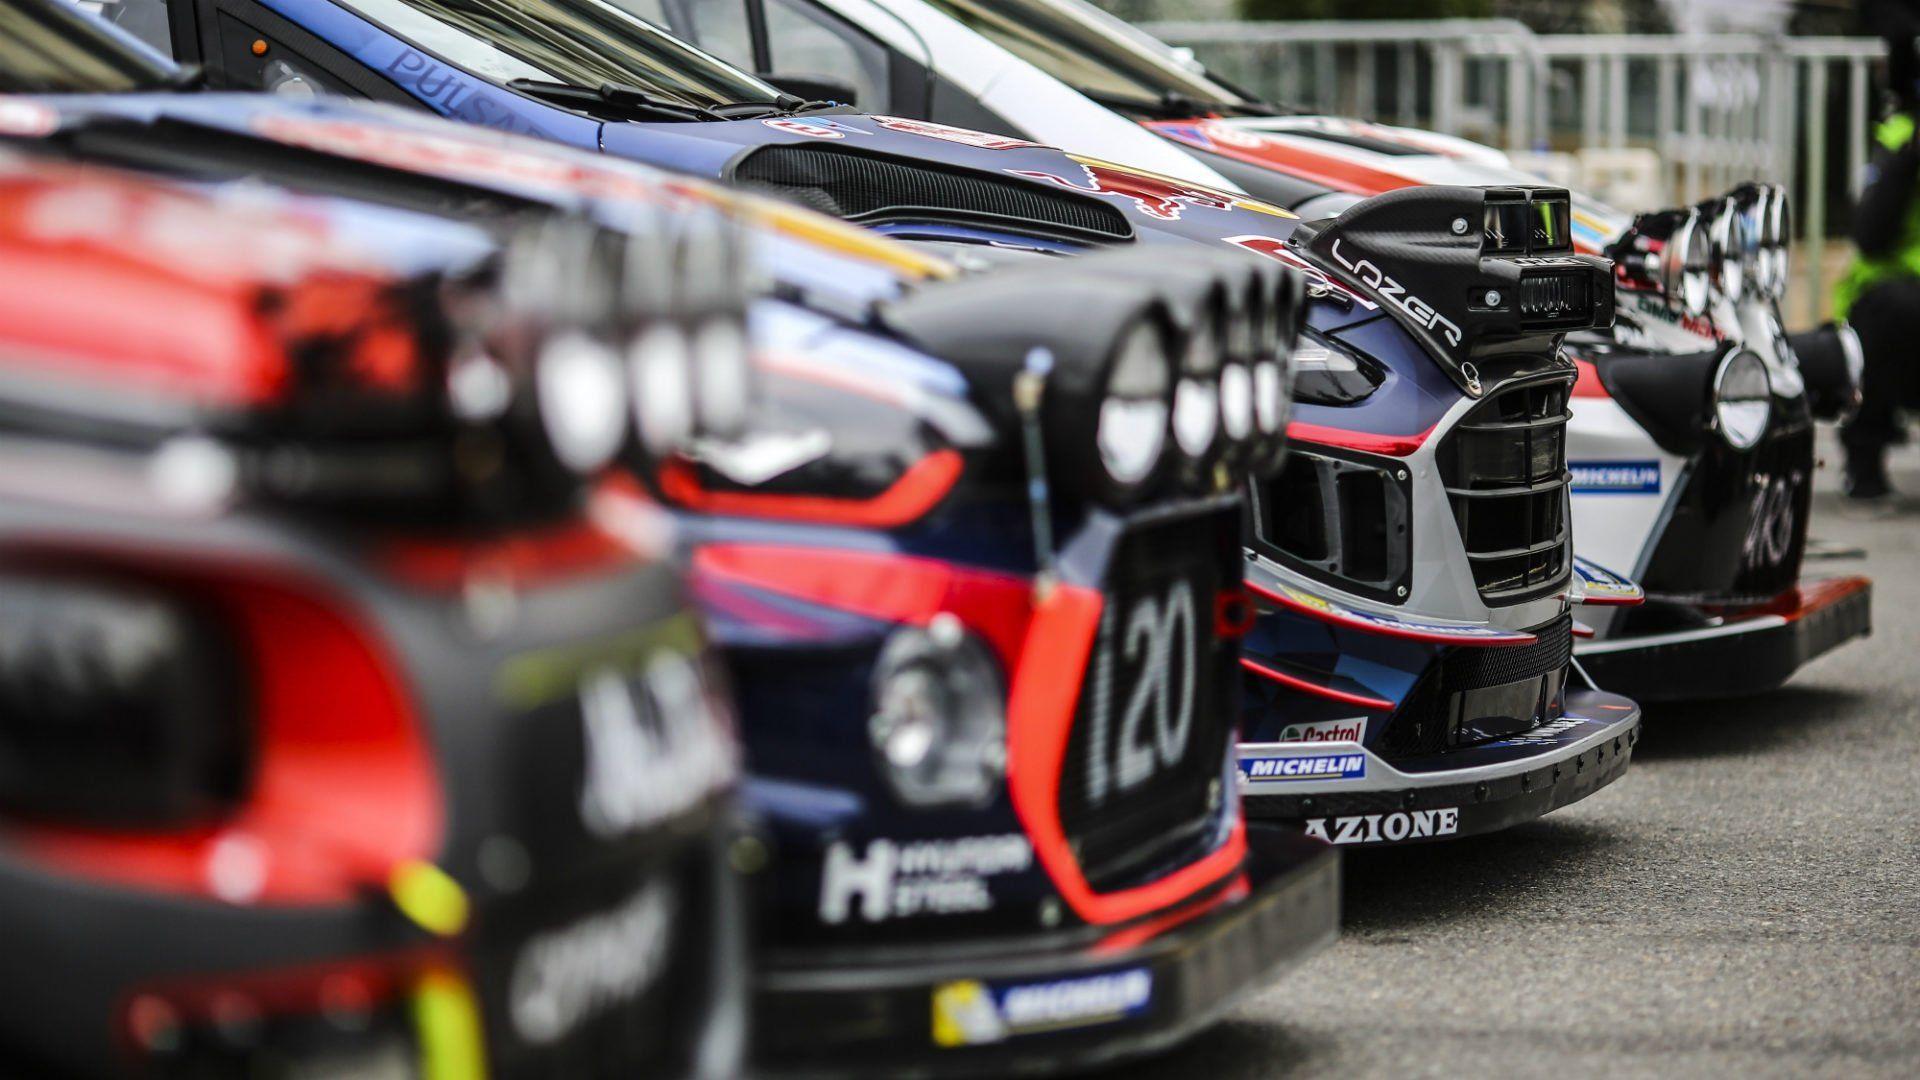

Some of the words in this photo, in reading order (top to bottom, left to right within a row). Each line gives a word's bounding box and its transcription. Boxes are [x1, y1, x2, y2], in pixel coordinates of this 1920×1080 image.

[1332, 238, 1462, 347] LAZER
[1302, 722, 1362, 742] Castrol
[1250, 756, 1364, 776] MICHELIN
[1304, 807, 1459, 844] AZIONE
